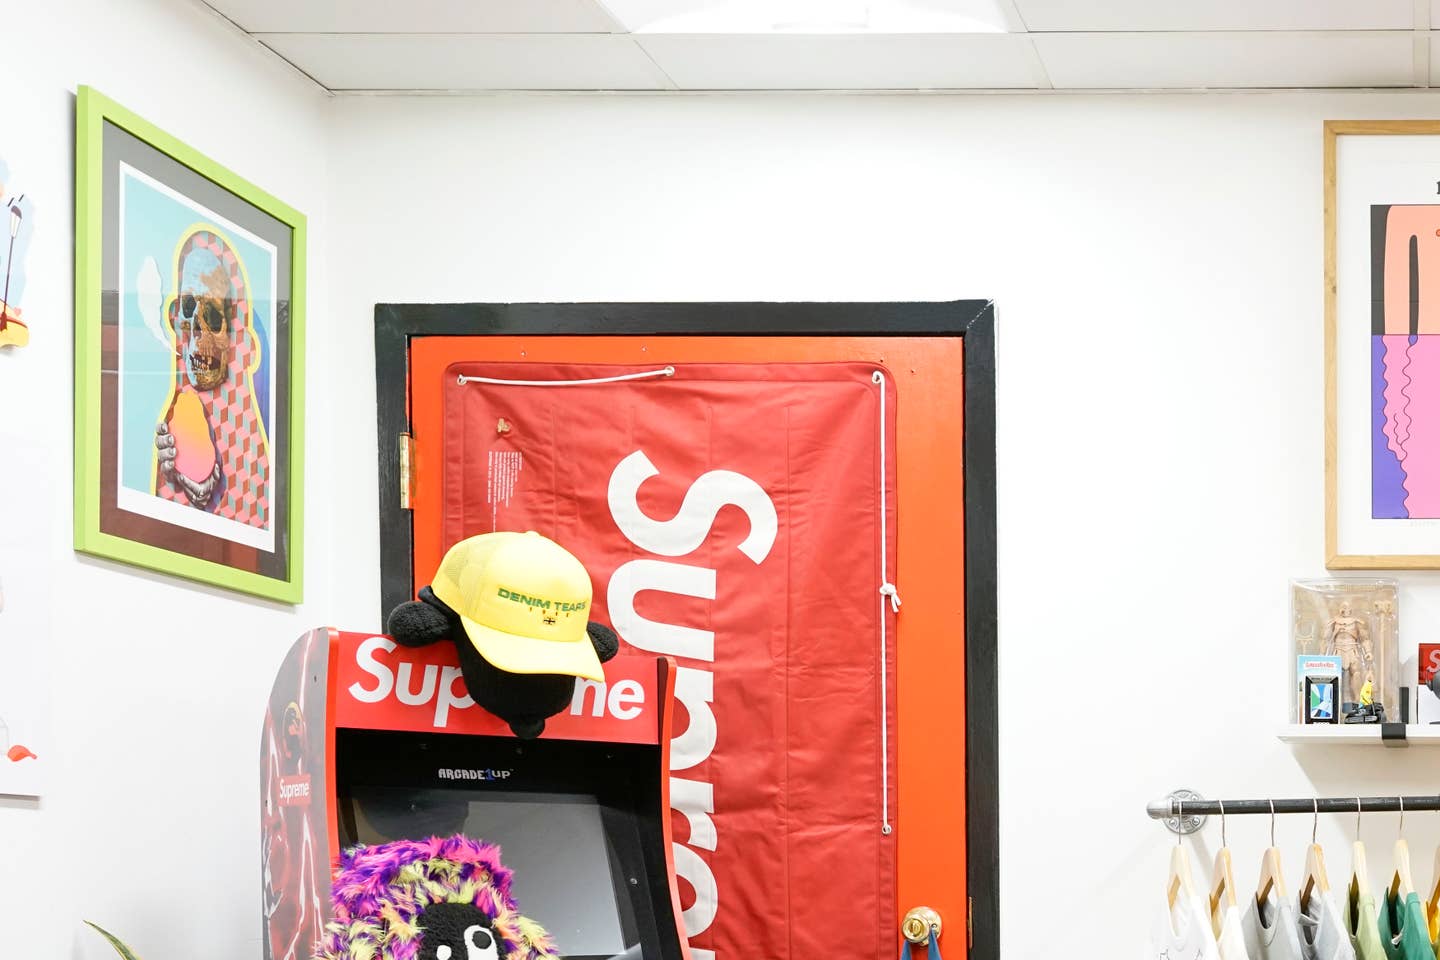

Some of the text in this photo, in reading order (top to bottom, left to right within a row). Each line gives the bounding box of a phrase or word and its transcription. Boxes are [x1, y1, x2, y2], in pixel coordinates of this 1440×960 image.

[497, 588, 586, 612] DENIM TEARS
[348, 637, 646, 728] Supme
[279, 778, 310, 804] Supreme
